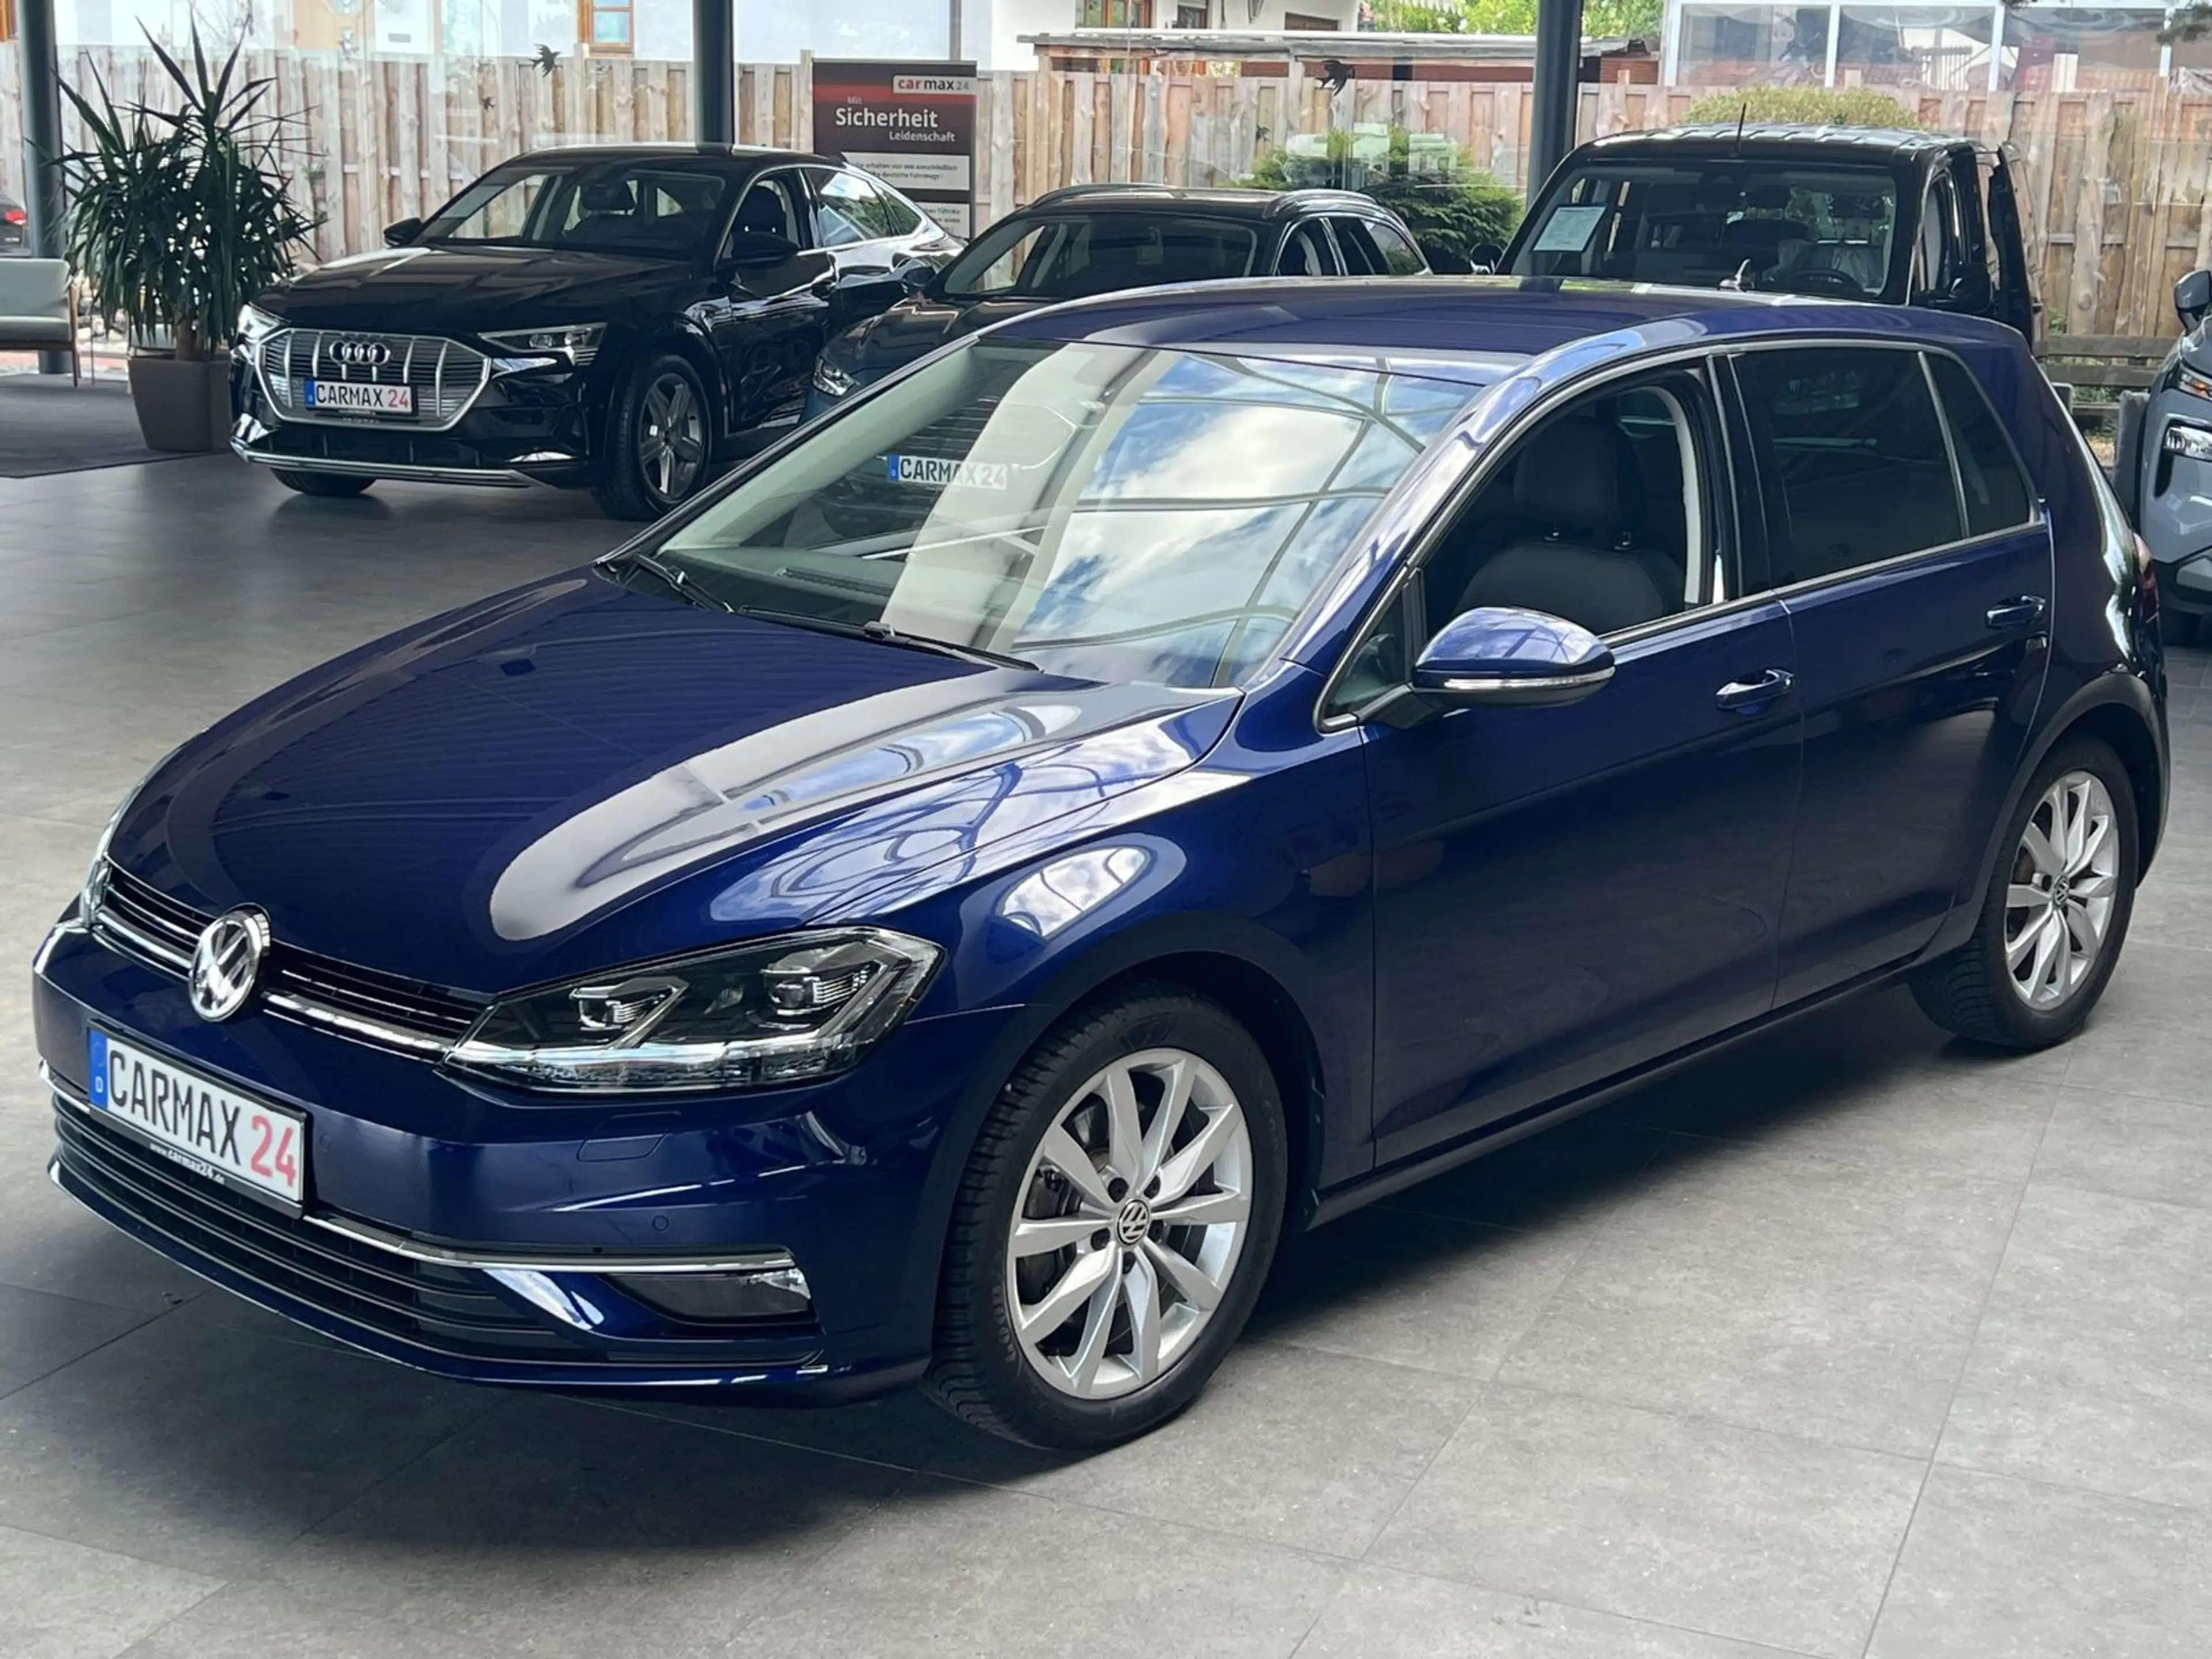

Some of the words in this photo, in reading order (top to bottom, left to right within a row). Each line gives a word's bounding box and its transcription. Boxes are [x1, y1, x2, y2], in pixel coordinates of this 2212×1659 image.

[835, 107, 938, 128] Sicherheit
[889, 130, 956, 142] Leidenschaft
[317, 384, 384, 408] CARMAX
[388, 389, 409, 408] 24
[900, 459, 977, 485] CARMAX
[981, 467, 1005, 487] 24
[109, 1049, 241, 1166] CARMAX
[250, 1115, 296, 1187] 24
